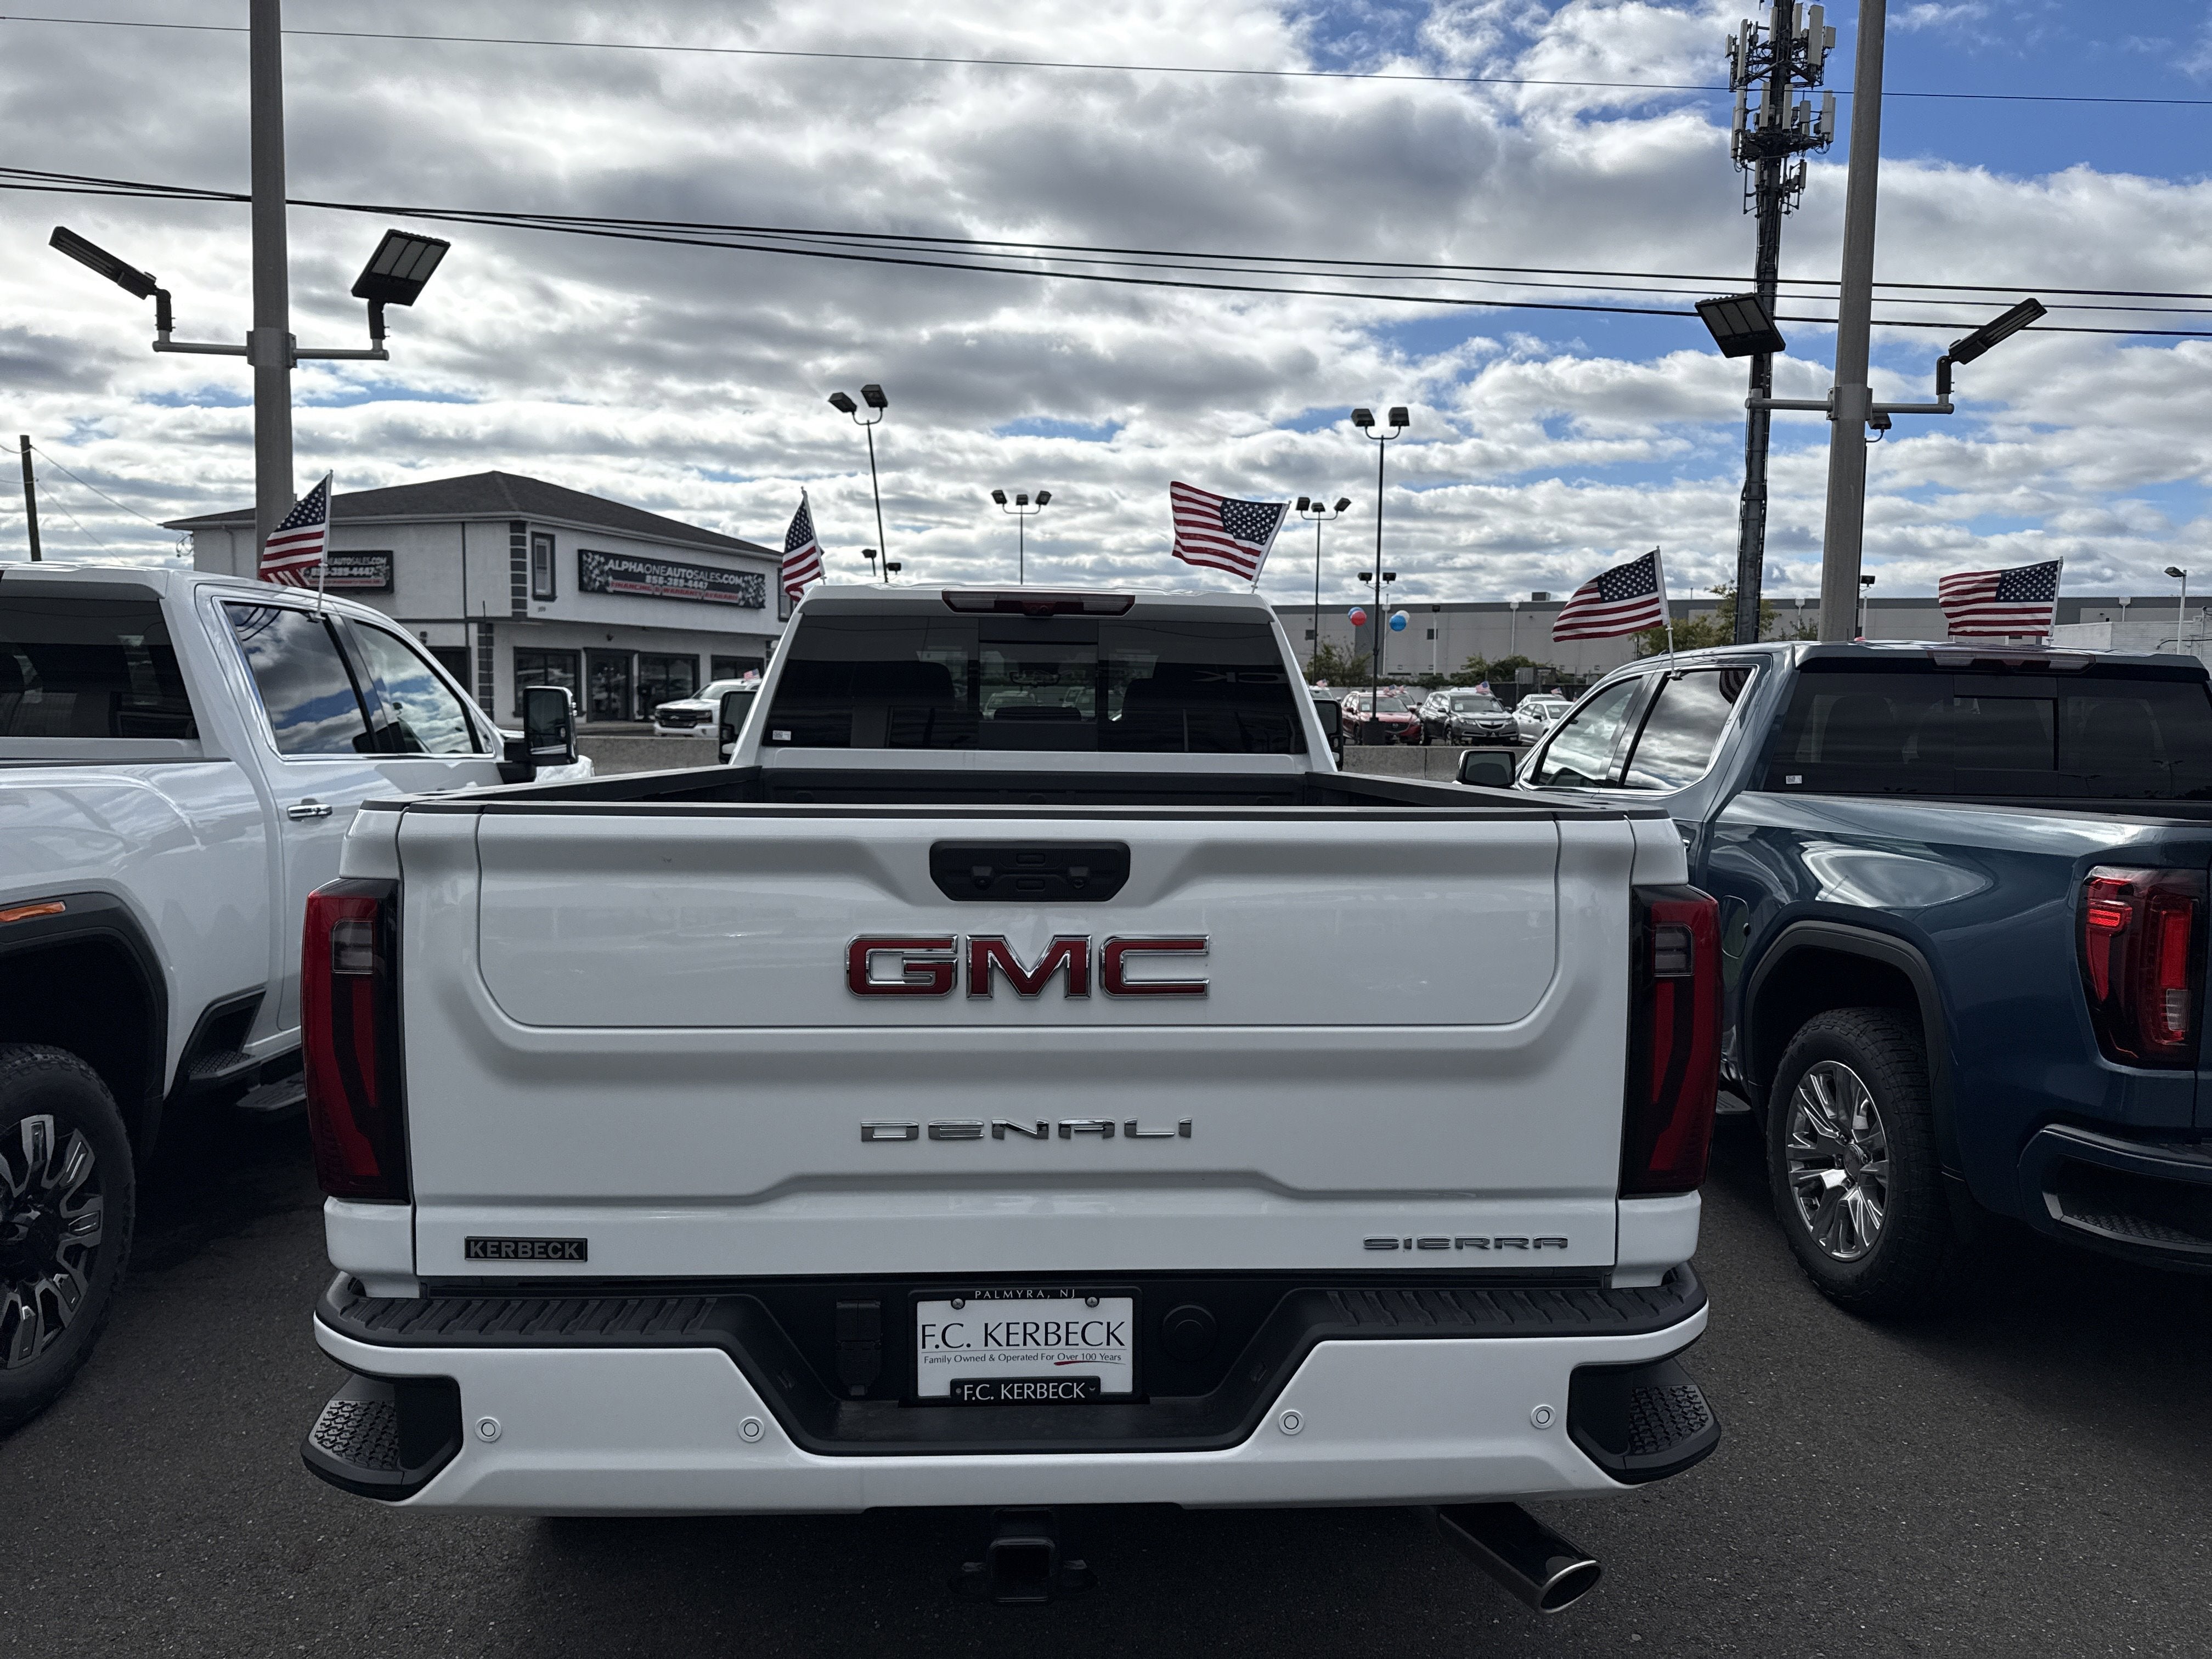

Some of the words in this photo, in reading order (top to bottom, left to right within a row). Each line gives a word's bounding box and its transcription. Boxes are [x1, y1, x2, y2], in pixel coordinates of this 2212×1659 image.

[608, 558, 743, 585] ALPHAONEAUTOSALES.COM
[845, 934, 1210, 999] GMC
[861, 1118, 1192, 1142] DENALI
[470, 1241, 579, 1259] KERBECK
[1364, 1235, 1568, 1249] SIERRA
[975, 1290, 1051, 1299] PALMYRA,
[1060, 1289, 1075, 1299] NJ
[921, 1323, 972, 1349] F.C.
[984, 1321, 1125, 1347] KERBECK
[924, 1355, 952, 1364] Family
[954, 1353, 986, 1362] Owned
[998, 1352, 1039, 1363] Operated
[1057, 1352, 1079, 1361] Over
[1081, 1352, 1097, 1361] 100
[1099, 1353, 1121, 1361] Years
[963, 1384, 995, 1401] F.C.
[1001, 1382, 1086, 1400] KERBECK
